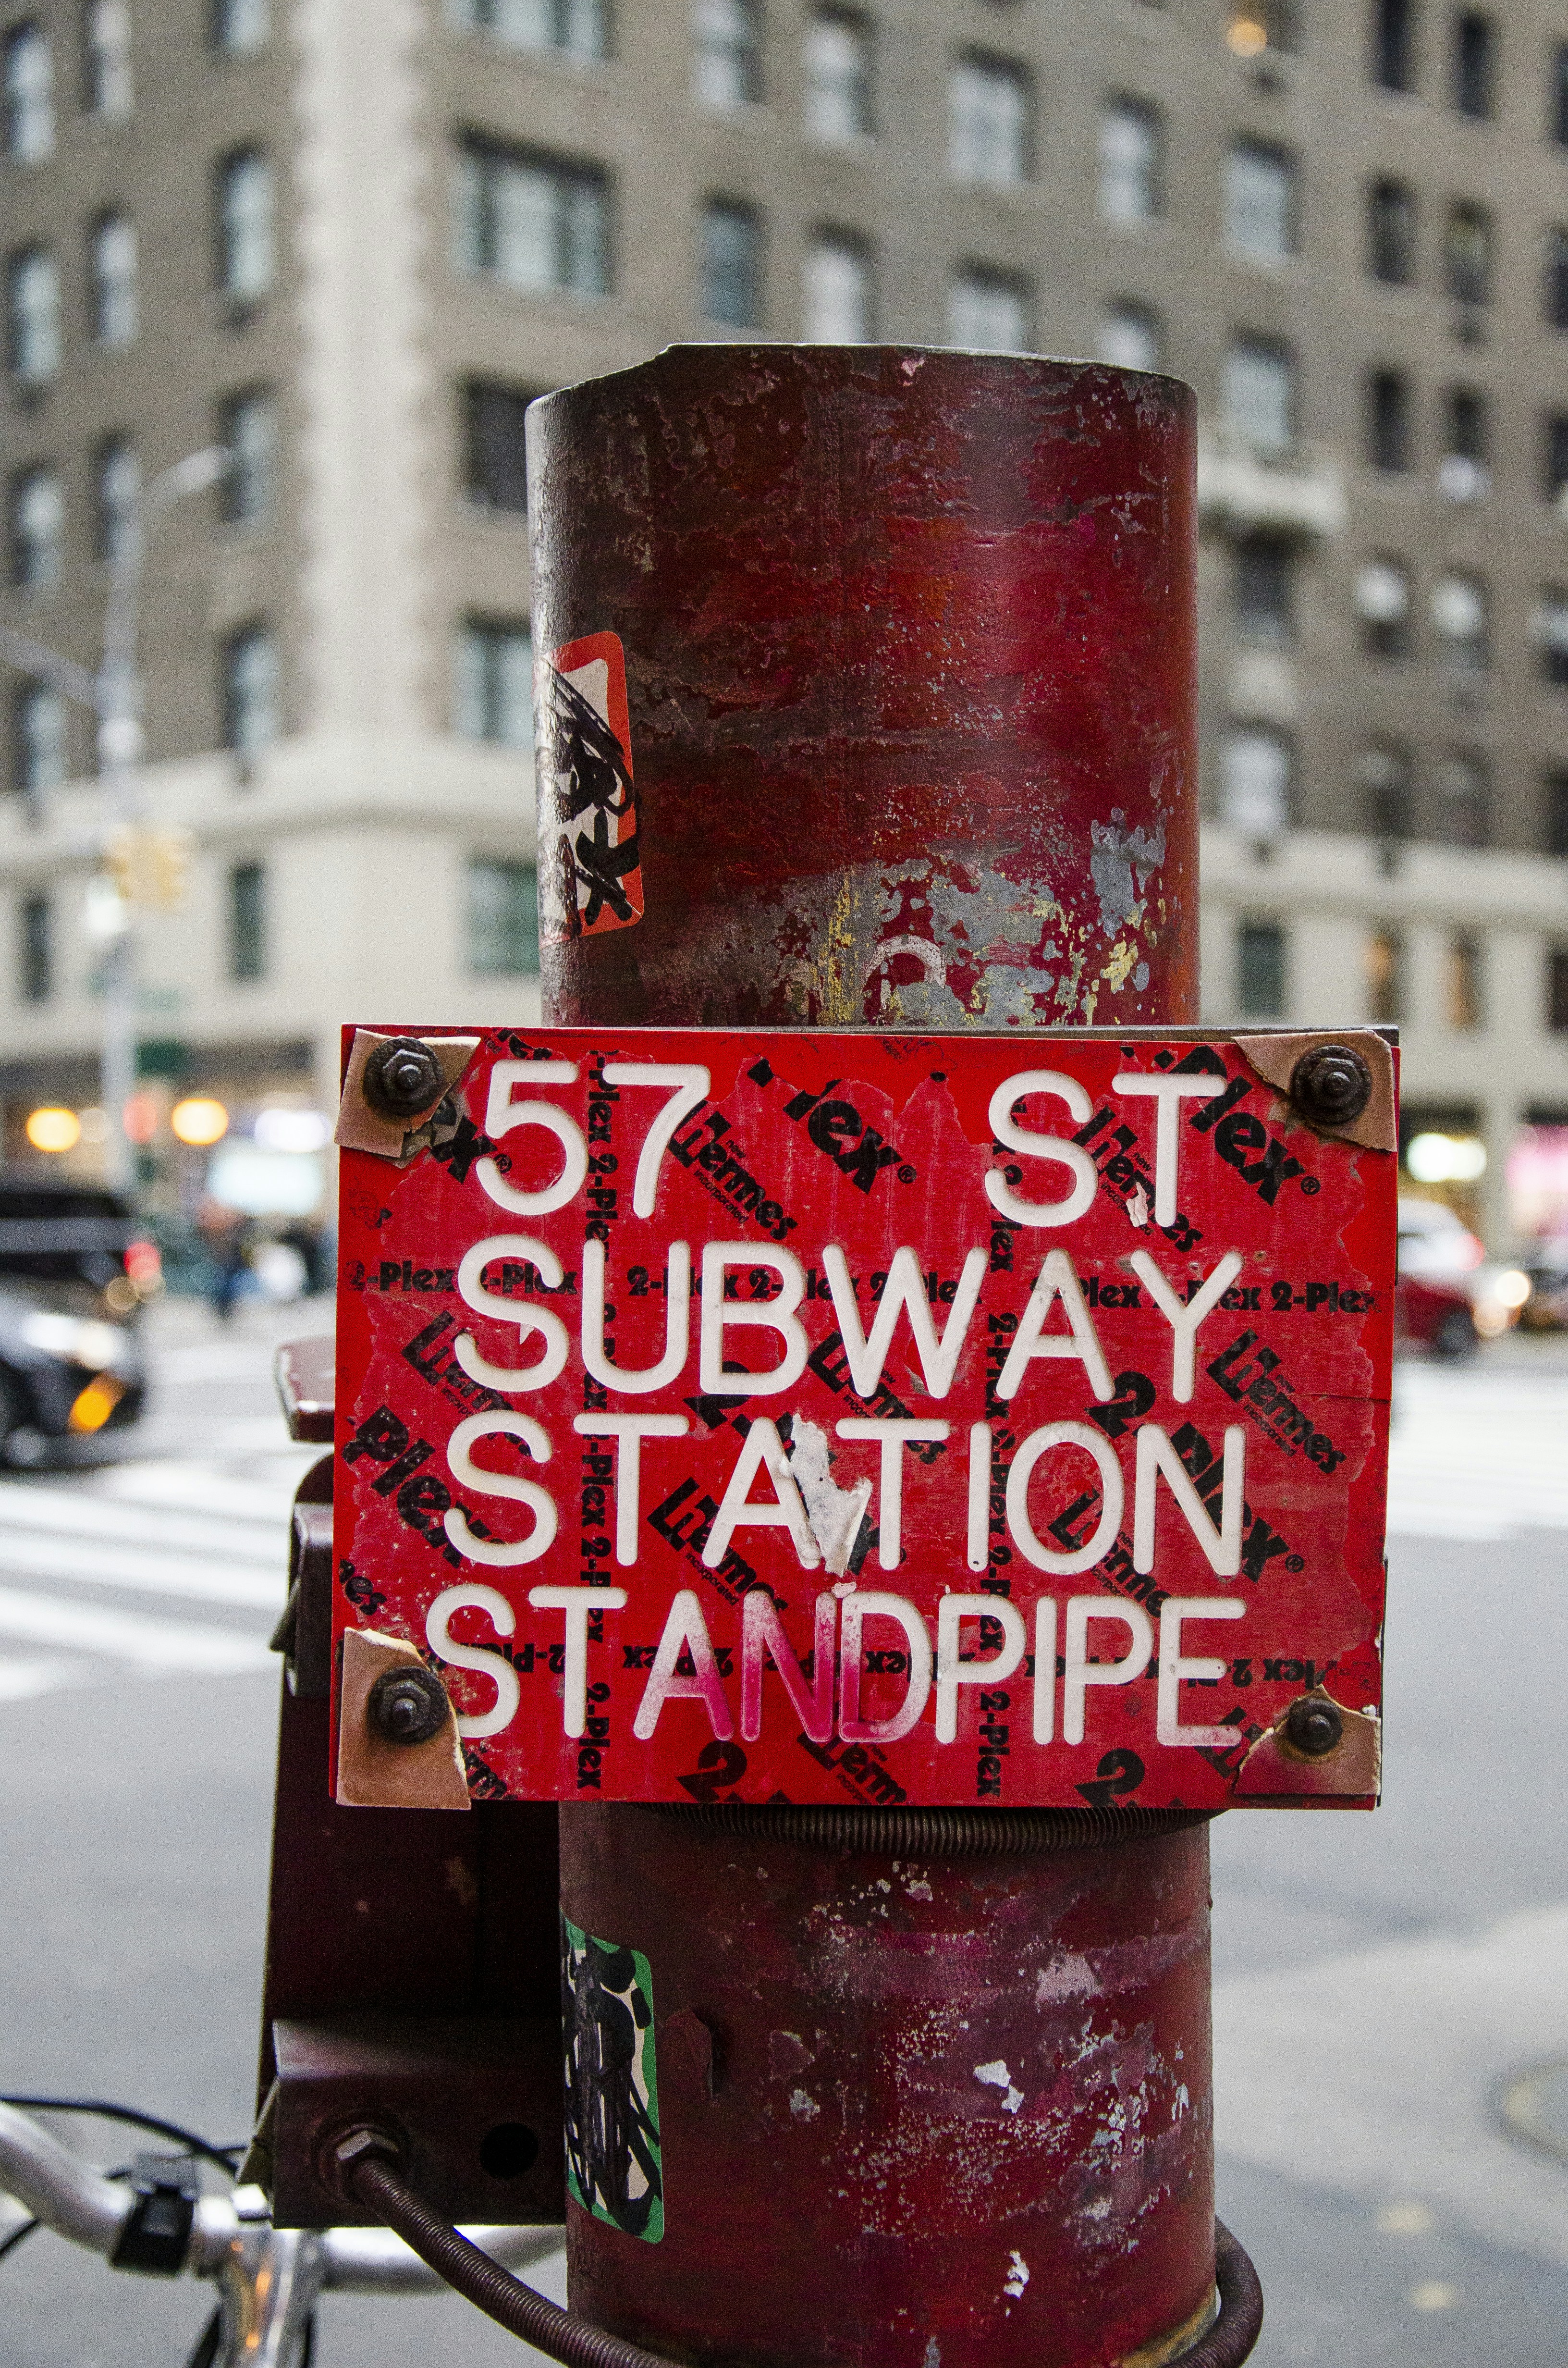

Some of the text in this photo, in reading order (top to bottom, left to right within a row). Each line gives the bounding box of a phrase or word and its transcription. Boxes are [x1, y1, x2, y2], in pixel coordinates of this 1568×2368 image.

[475, 1059, 711, 1219] 57
[984, 1069, 1228, 1228] ST
[454, 1234, 1244, 1403] SUBWAY
[443, 1410, 1247, 1576] STATION
[426, 1583, 1248, 1747] STANDPIPE
